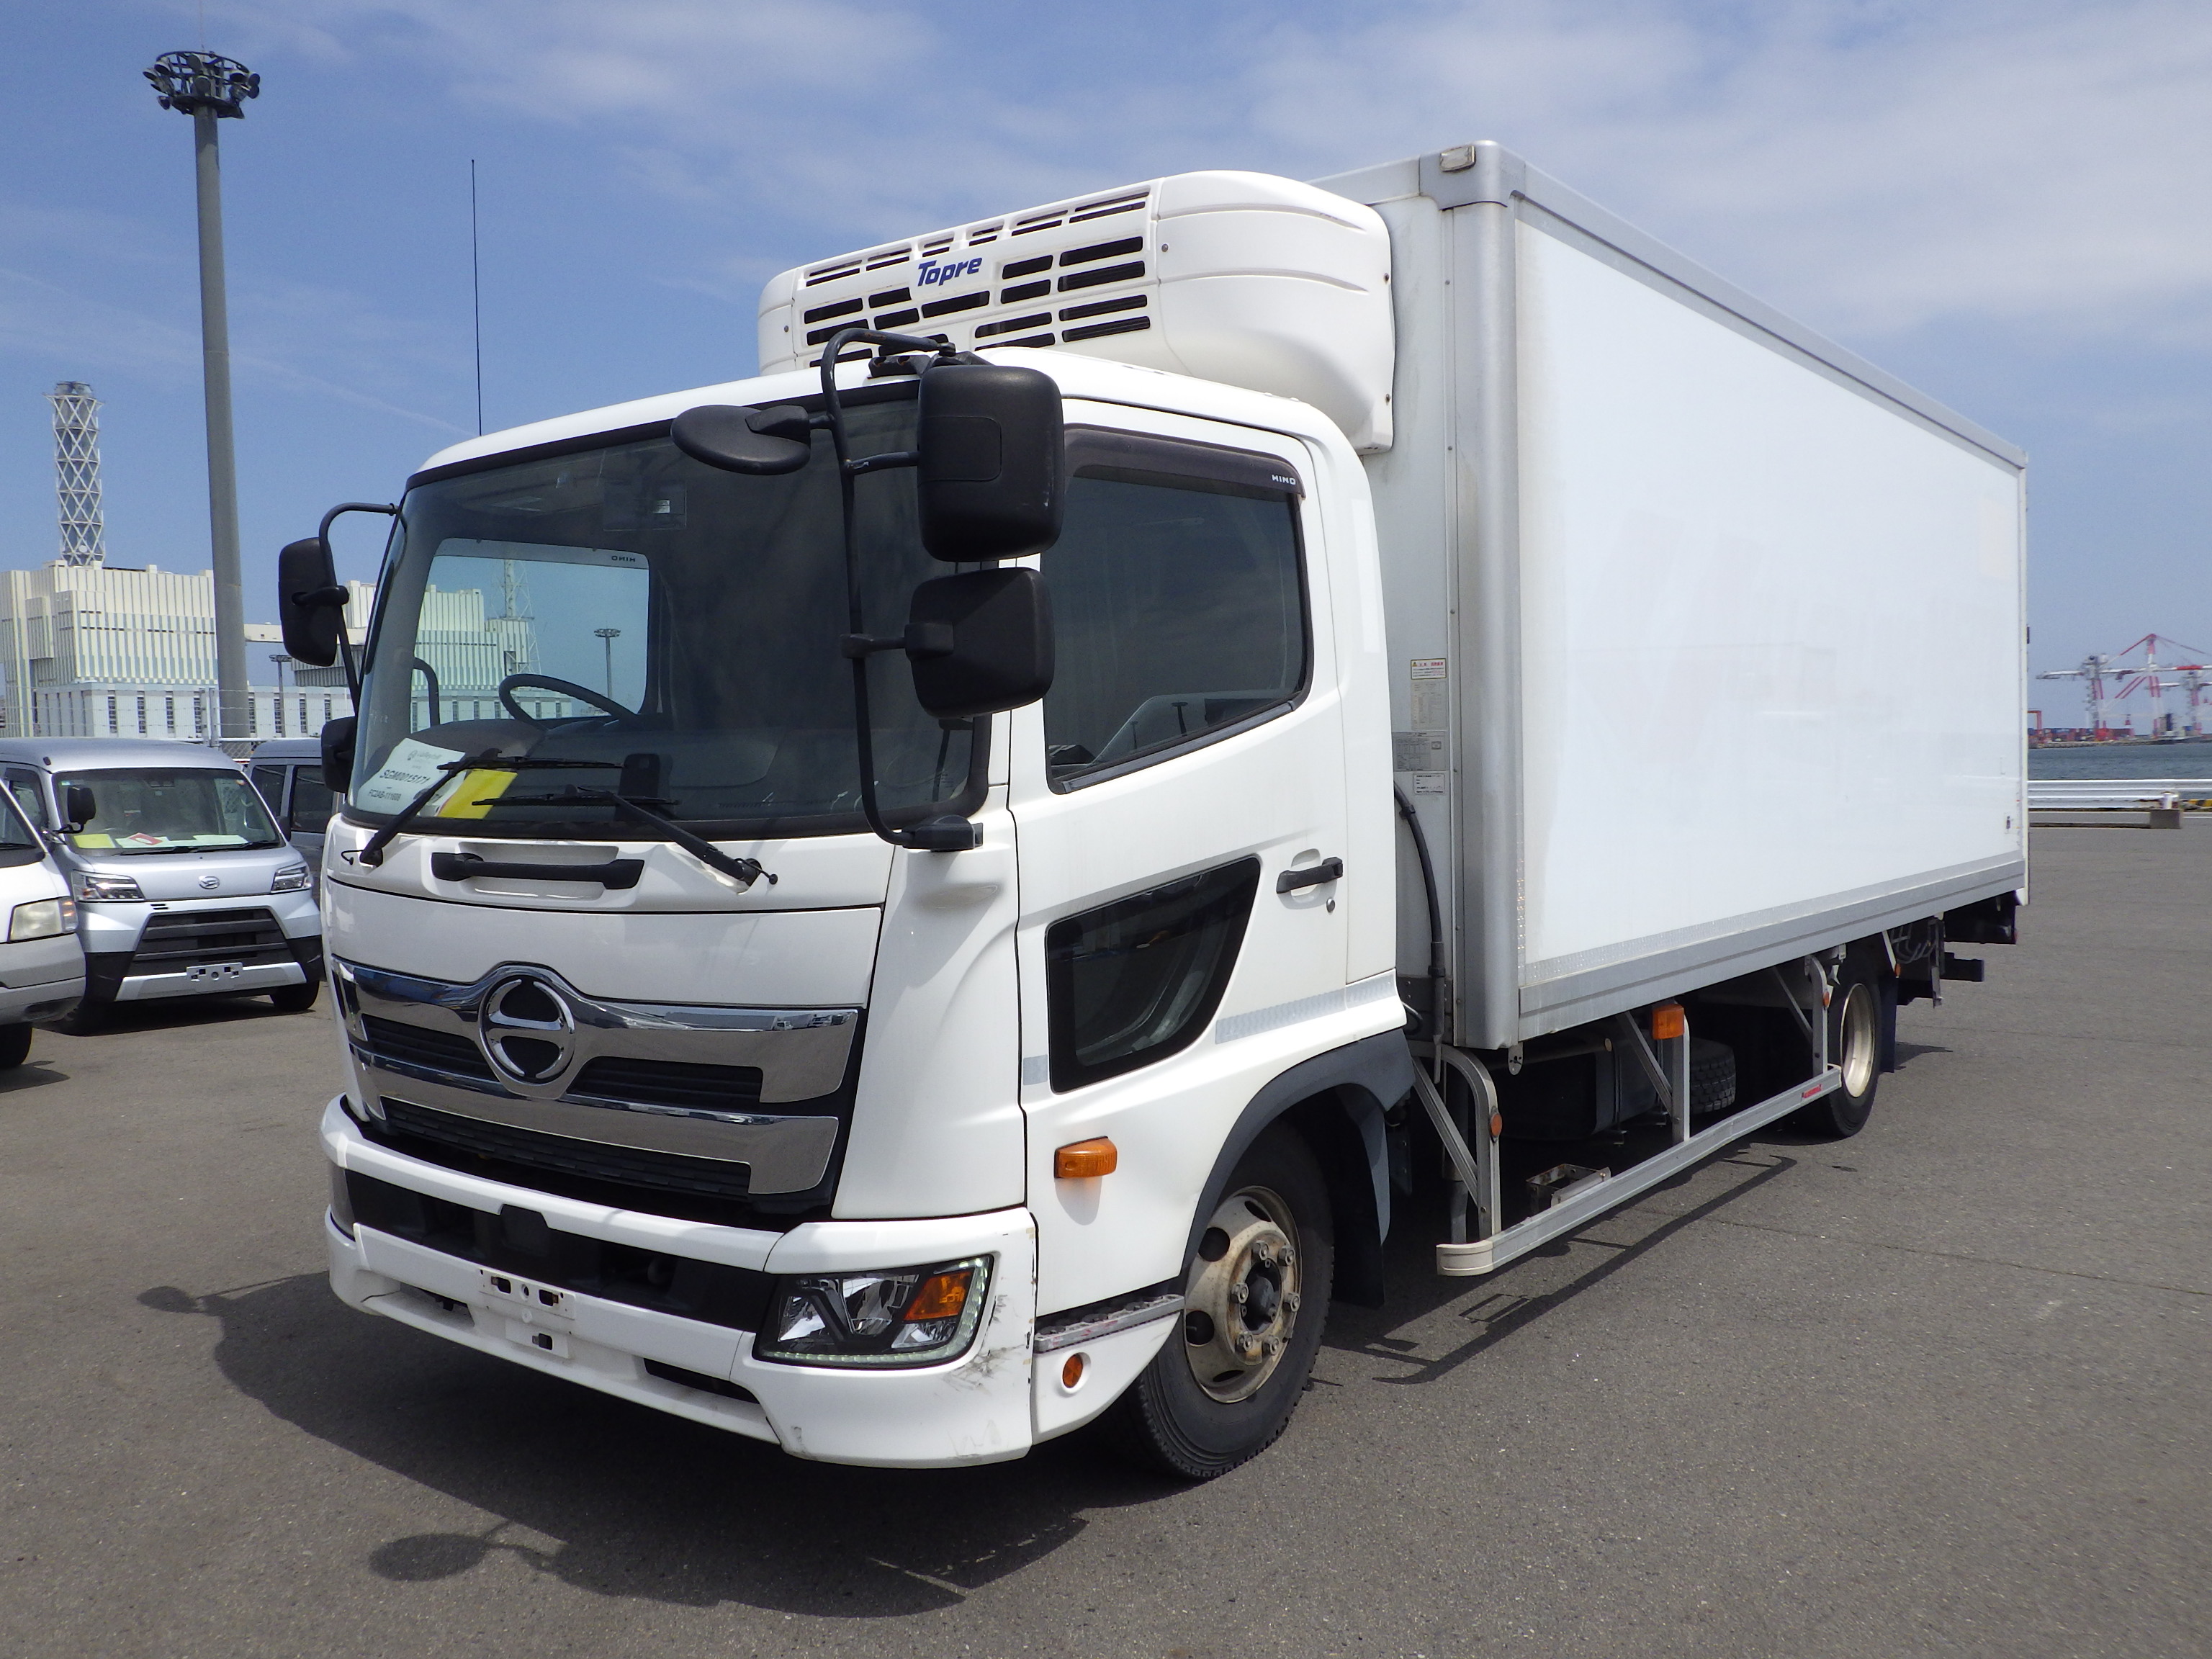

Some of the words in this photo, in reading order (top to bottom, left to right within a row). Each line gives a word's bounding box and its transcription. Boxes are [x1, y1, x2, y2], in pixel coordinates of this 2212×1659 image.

[917, 257, 983, 287] Topre
[1272, 475, 1296, 485] HINO
[379, 769, 431, 785] SGM0015171
